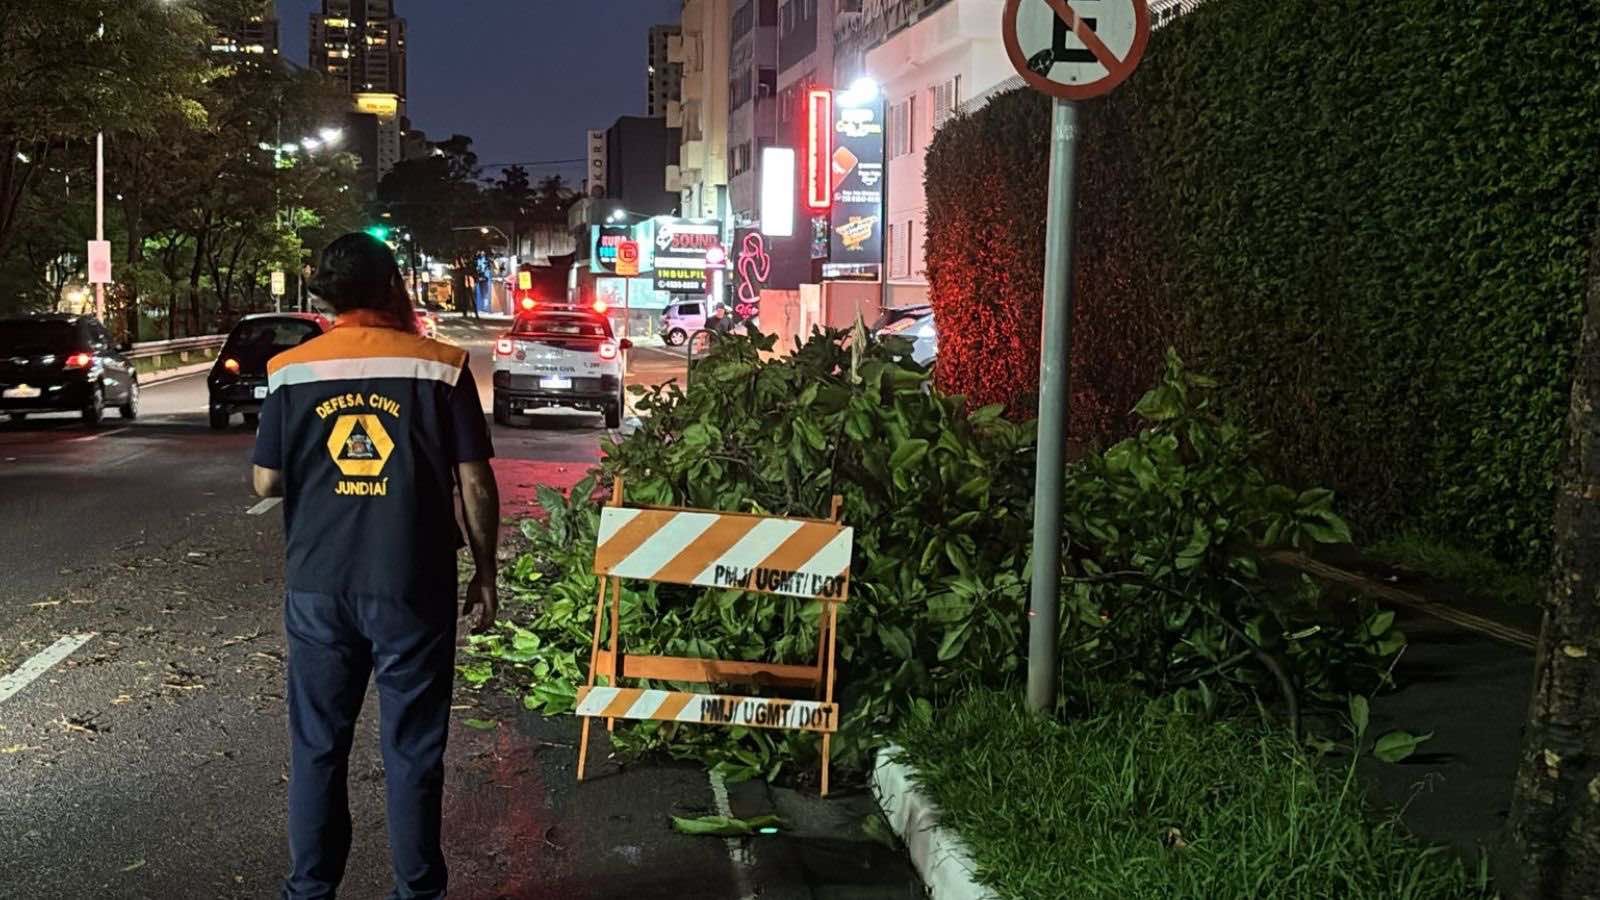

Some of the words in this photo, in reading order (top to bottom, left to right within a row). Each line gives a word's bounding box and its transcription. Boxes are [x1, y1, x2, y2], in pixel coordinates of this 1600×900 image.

[672, 232, 718, 249] SOUND
[315, 393, 365, 419] DEFESA
[369, 393, 401, 418] CIVIL
[335, 477, 390, 496] JUNDIAÍ
[811, 573, 847, 598] DOT
[799, 705, 833, 727] DOT
